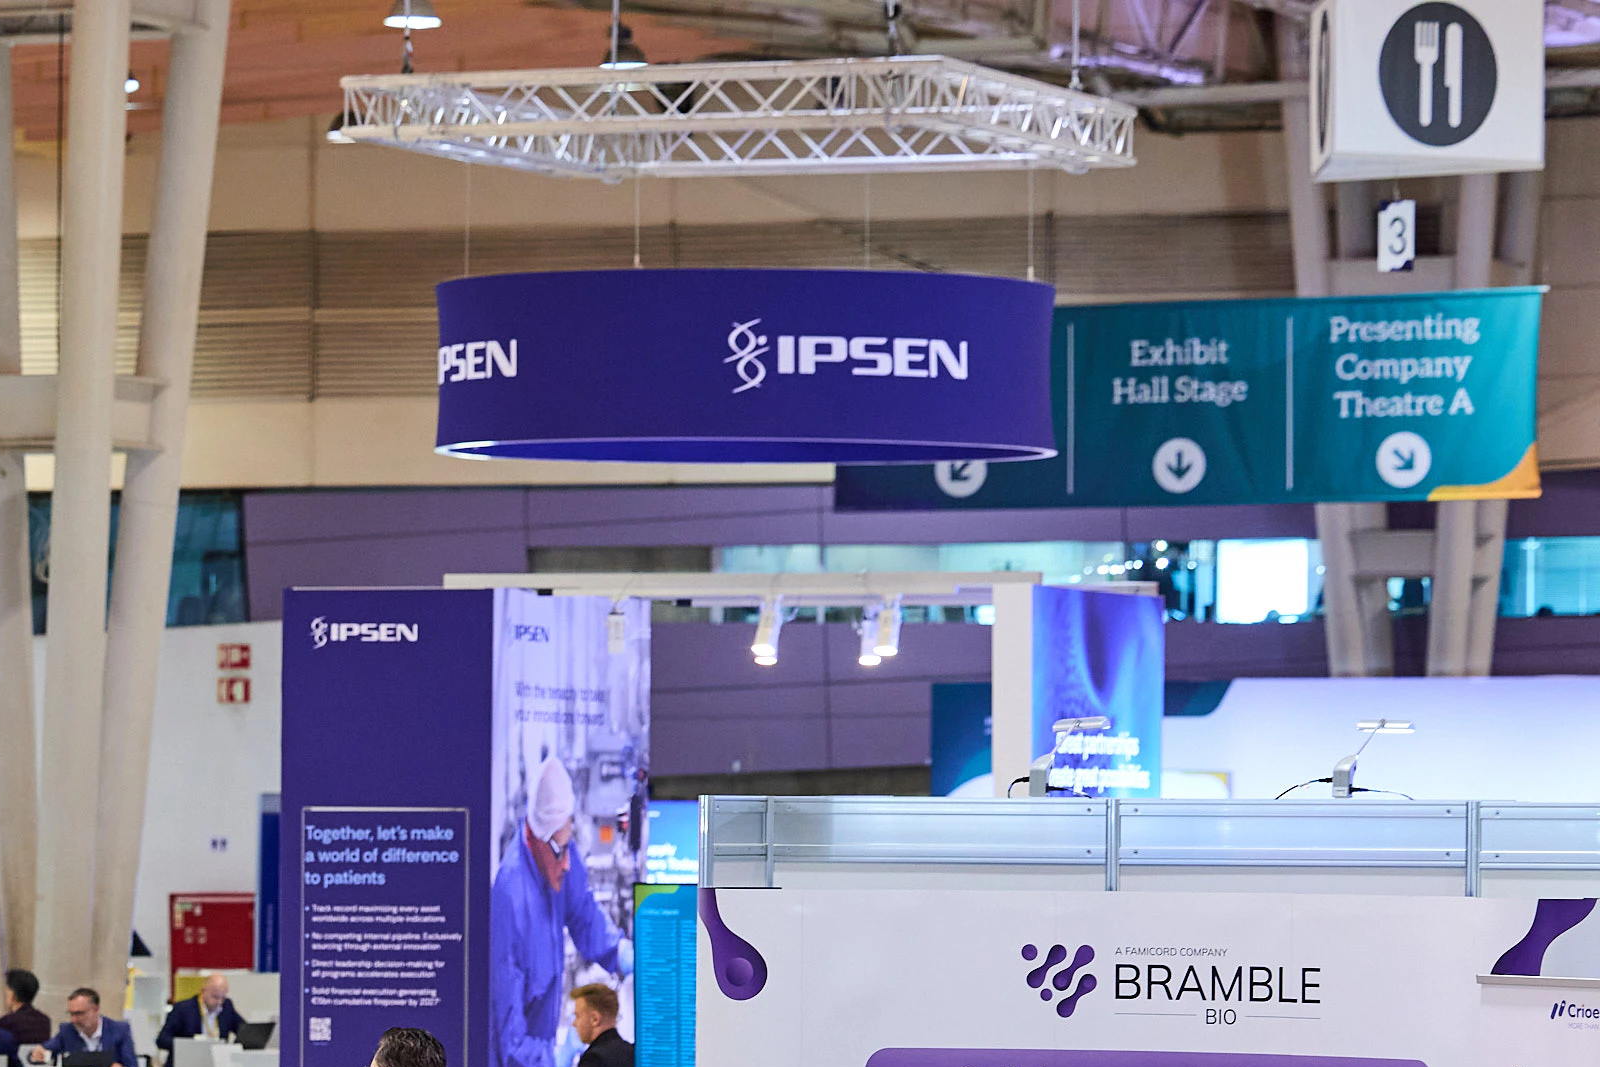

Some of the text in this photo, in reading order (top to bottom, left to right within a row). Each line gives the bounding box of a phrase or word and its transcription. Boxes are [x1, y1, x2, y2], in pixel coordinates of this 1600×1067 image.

[1388, 216, 1406, 254] 3
[1329, 313, 1481, 345] Presenting
[778, 336, 968, 380] IPSEN
[1130, 338, 1229, 367] Exhibit
[1334, 353, 1474, 384] Company
[1112, 375, 1248, 407] Hall Stage
[1333, 387, 1475, 420] Theatre A
[330, 622, 419, 642] IPSEN
[306, 825, 454, 844] Together, let's make
[305, 848, 460, 863] a world of difference
[305, 869, 386, 888] to patients
[1115, 946, 1228, 957] A FAMICORD COMPANY
[1115, 964, 1321, 1004] BRAMBLE
[1205, 1009, 1237, 1025] BIO
